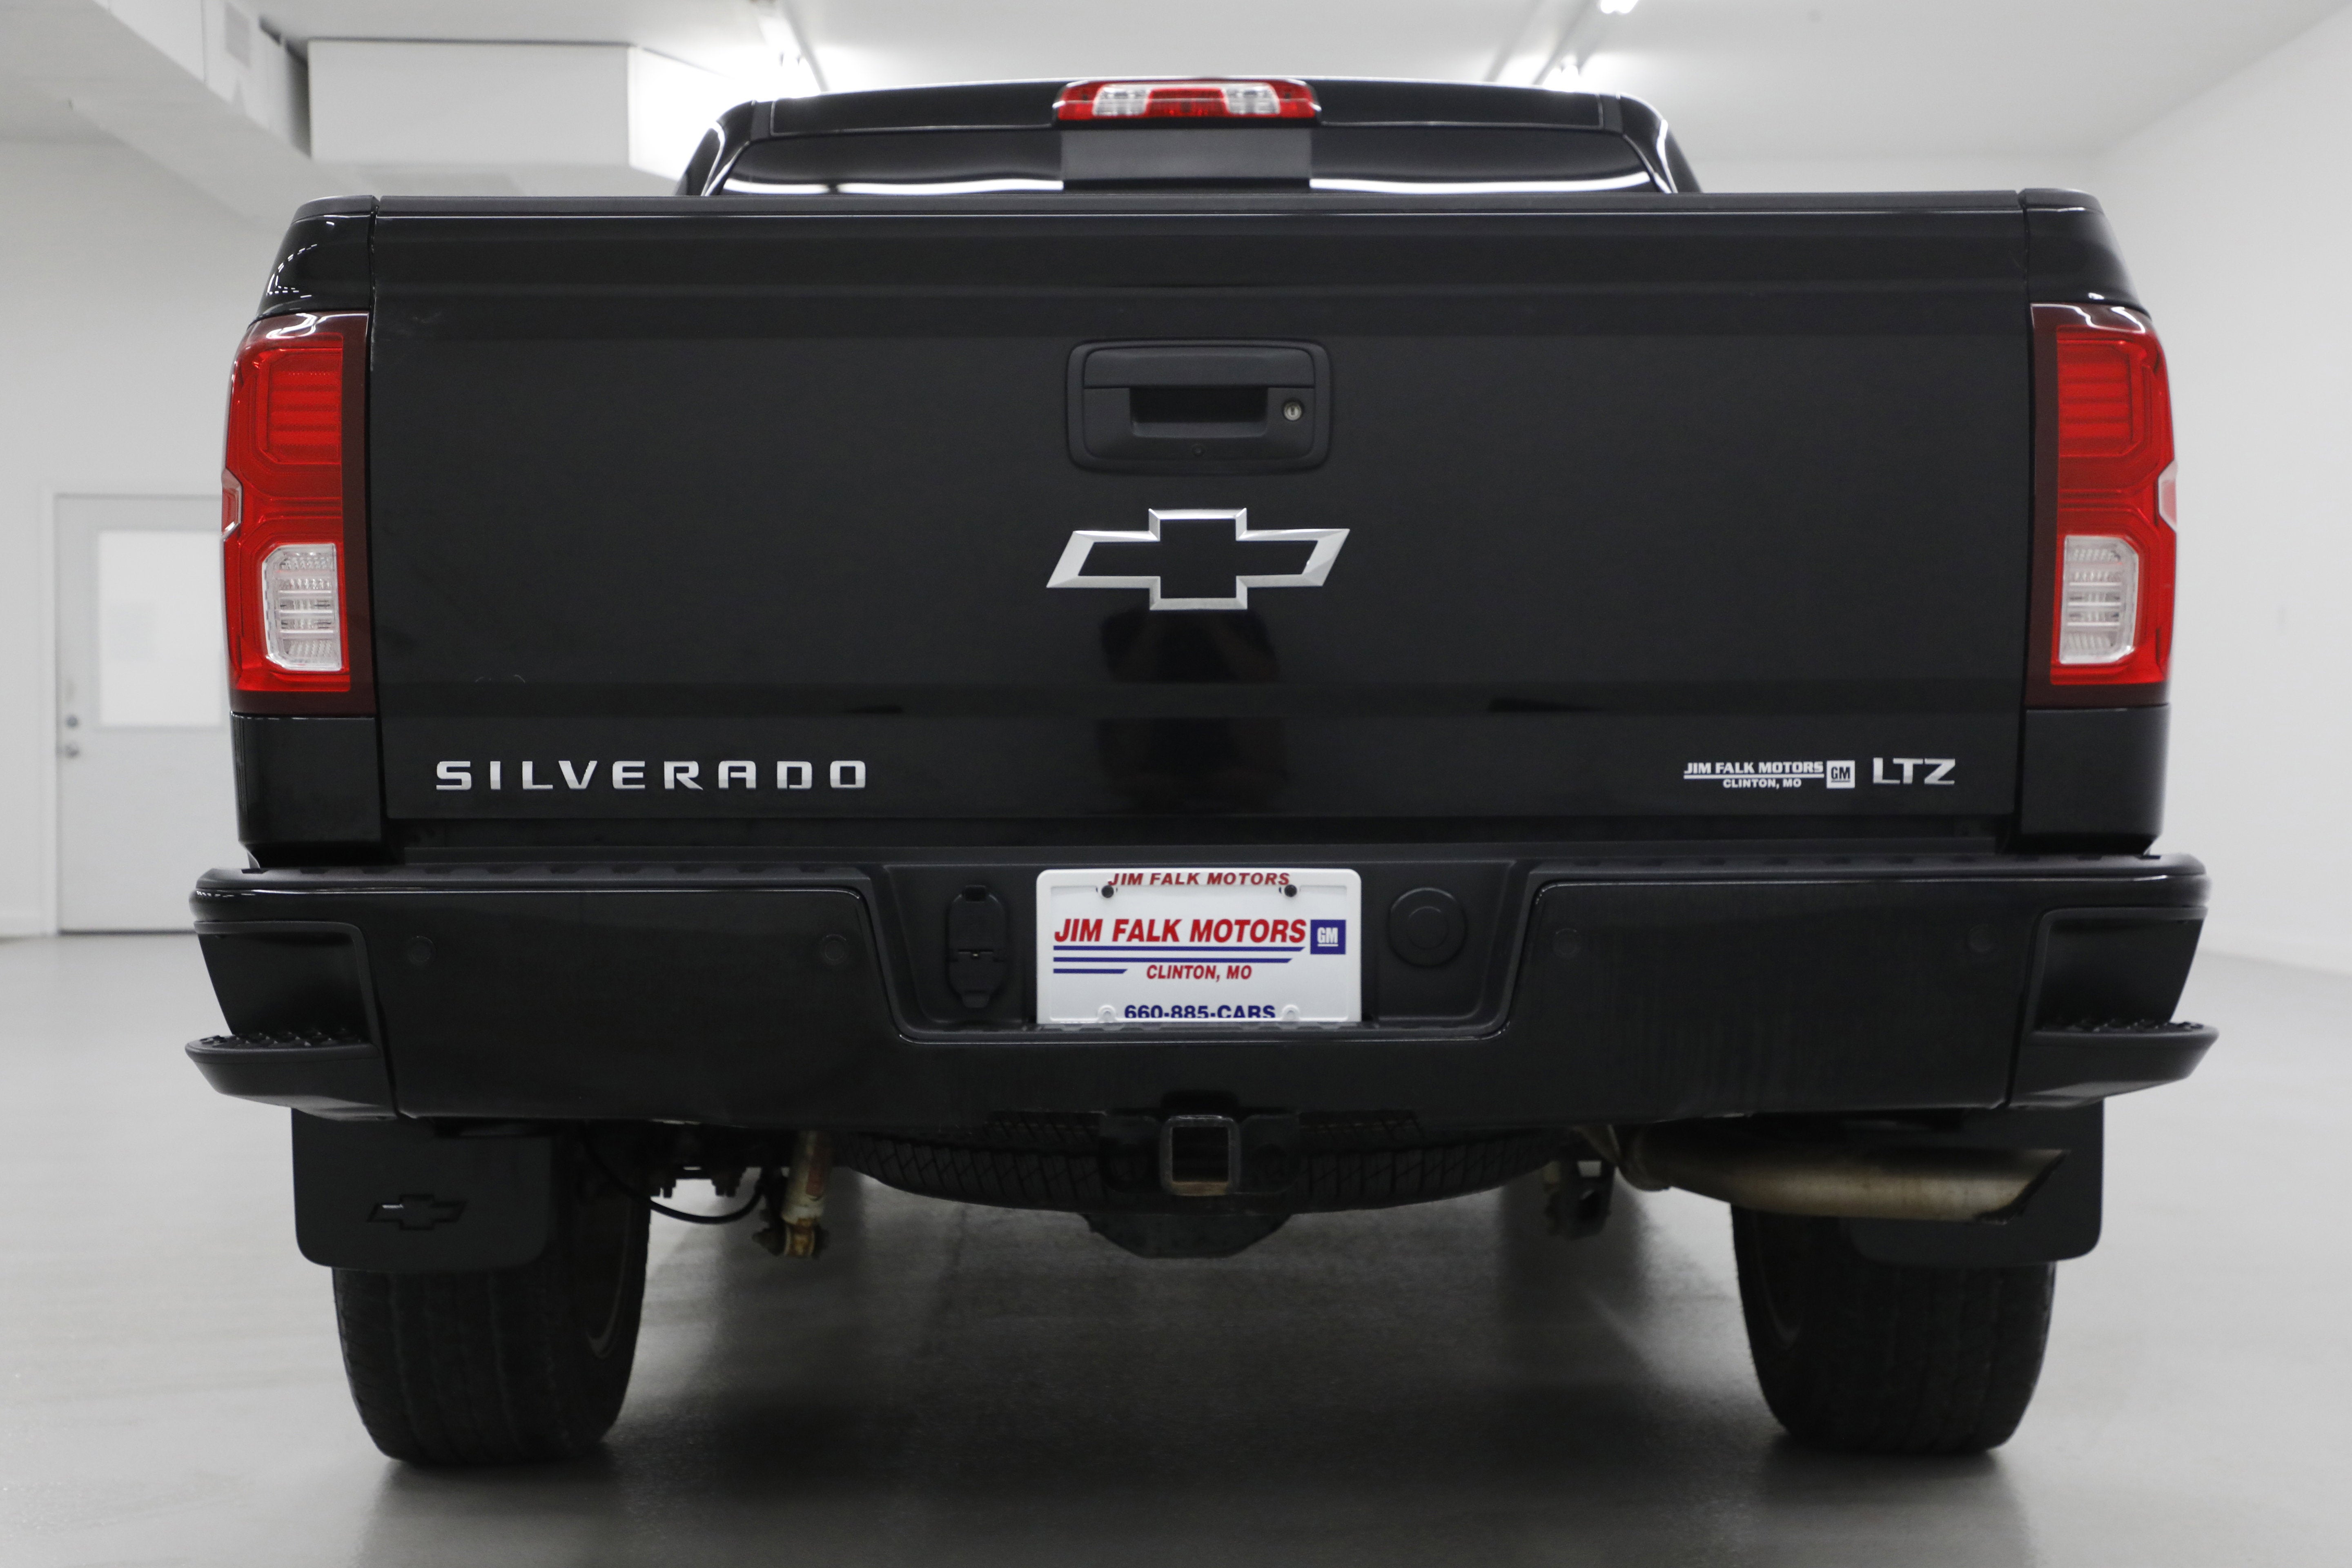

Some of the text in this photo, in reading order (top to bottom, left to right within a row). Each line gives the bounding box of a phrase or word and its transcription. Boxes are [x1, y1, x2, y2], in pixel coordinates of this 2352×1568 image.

[436, 760, 866, 791] SILVERADO
[1684, 761, 1824, 774] JIM FALK MOTORS
[1831, 766, 1850, 781] GM
[1873, 757, 1956, 785] LTZ
[1723, 778, 1802, 789] CLINTON, MO
[1107, 873, 1290, 885] JIM FALK MOTORS
[1054, 919, 1306, 943] JIM FALK MOTORS
[1317, 927, 1339, 944] GM
[1146, 965, 1252, 982] CLINTON, MO
[1125, 1005, 1275, 1018] 660-885-CARS
